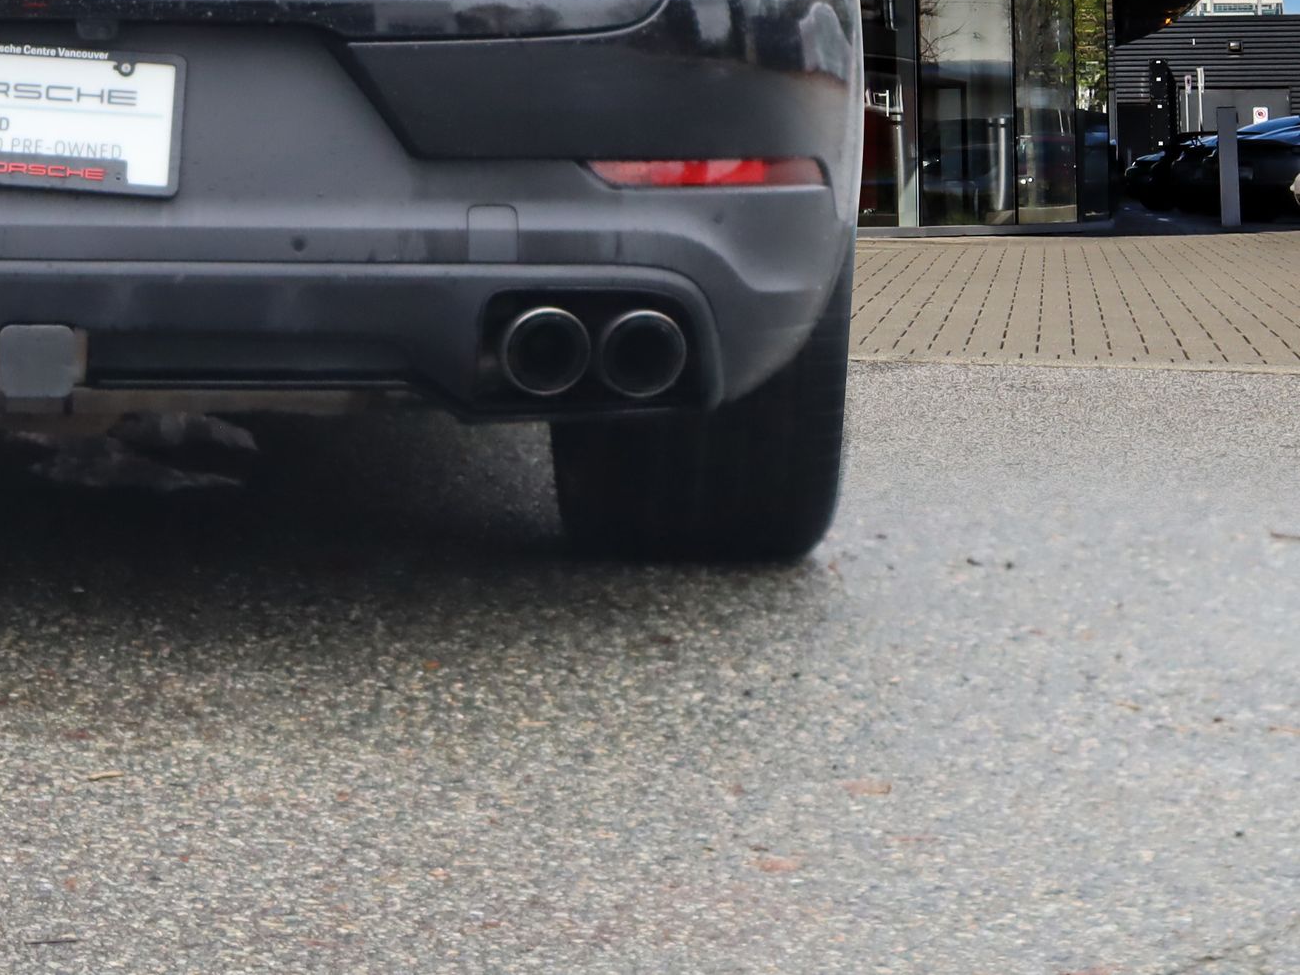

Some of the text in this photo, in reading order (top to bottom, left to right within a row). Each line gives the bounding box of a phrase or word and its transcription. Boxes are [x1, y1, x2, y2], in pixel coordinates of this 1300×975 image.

[23, 45, 56, 57] Centre
[57, 47, 109, 60] Vancouver
[11, 138, 122, 159] PRE-OWNED
